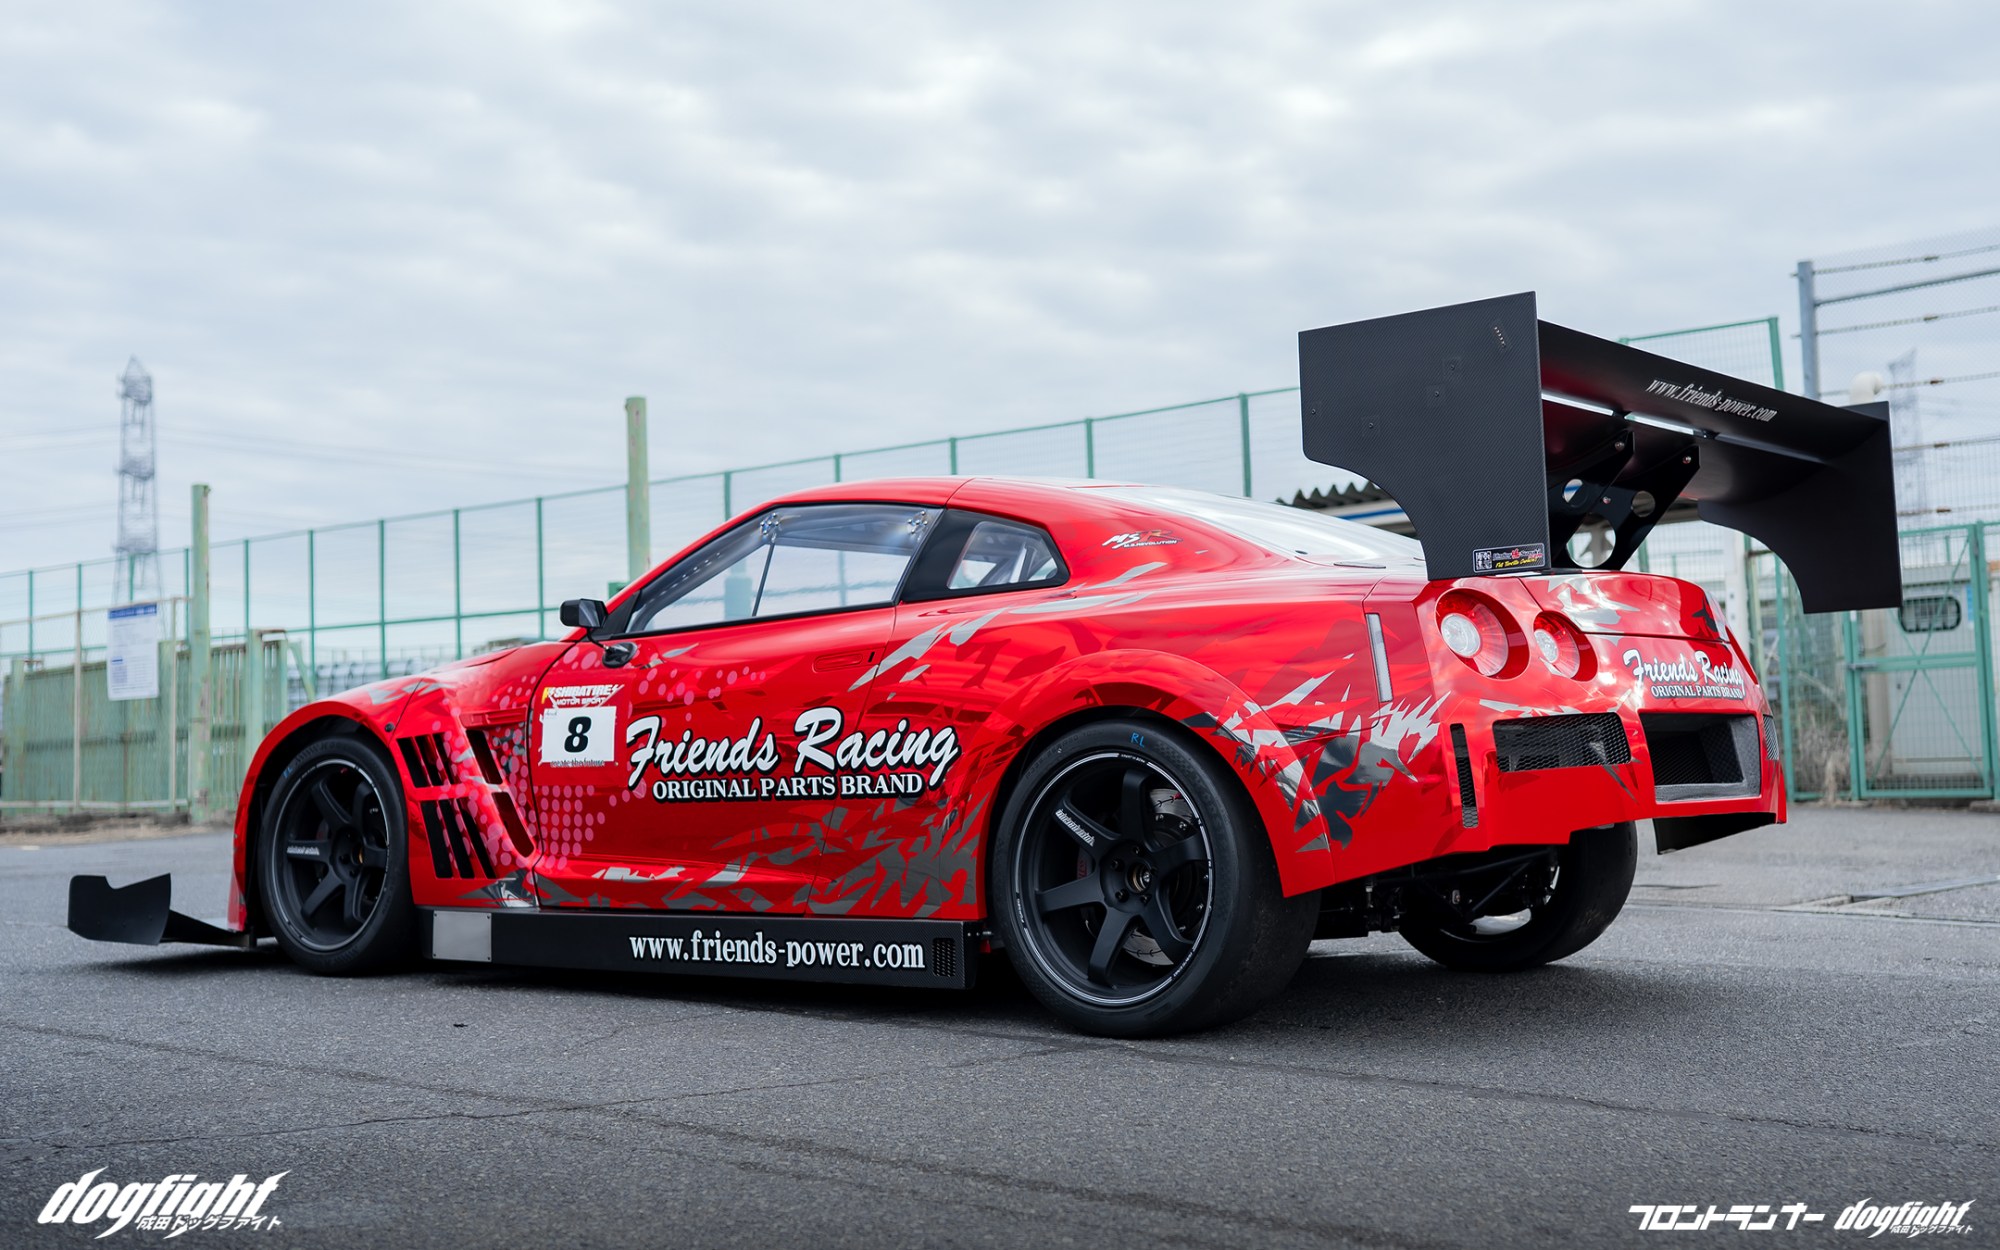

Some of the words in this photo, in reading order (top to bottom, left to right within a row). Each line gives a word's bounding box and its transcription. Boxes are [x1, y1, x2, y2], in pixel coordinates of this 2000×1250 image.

[1645, 379, 1778, 422] www.friends-power.com
[1622, 649, 1699, 689] Friends
[1694, 650, 1746, 696] Racing
[1651, 685, 1697, 698] ORIGINAL
[1697, 686, 1723, 698] PARTS
[1722, 686, 1744, 700] BRAND
[564, 716, 592, 753] 8
[626, 716, 778, 790] Friends
[794, 707, 960, 787] Racing
[653, 778, 757, 801] ORIGINAL
[760, 775, 837, 798] PARTS
[839, 772, 923, 795] BRAND
[629, 929, 926, 969] www.friends-power.com
